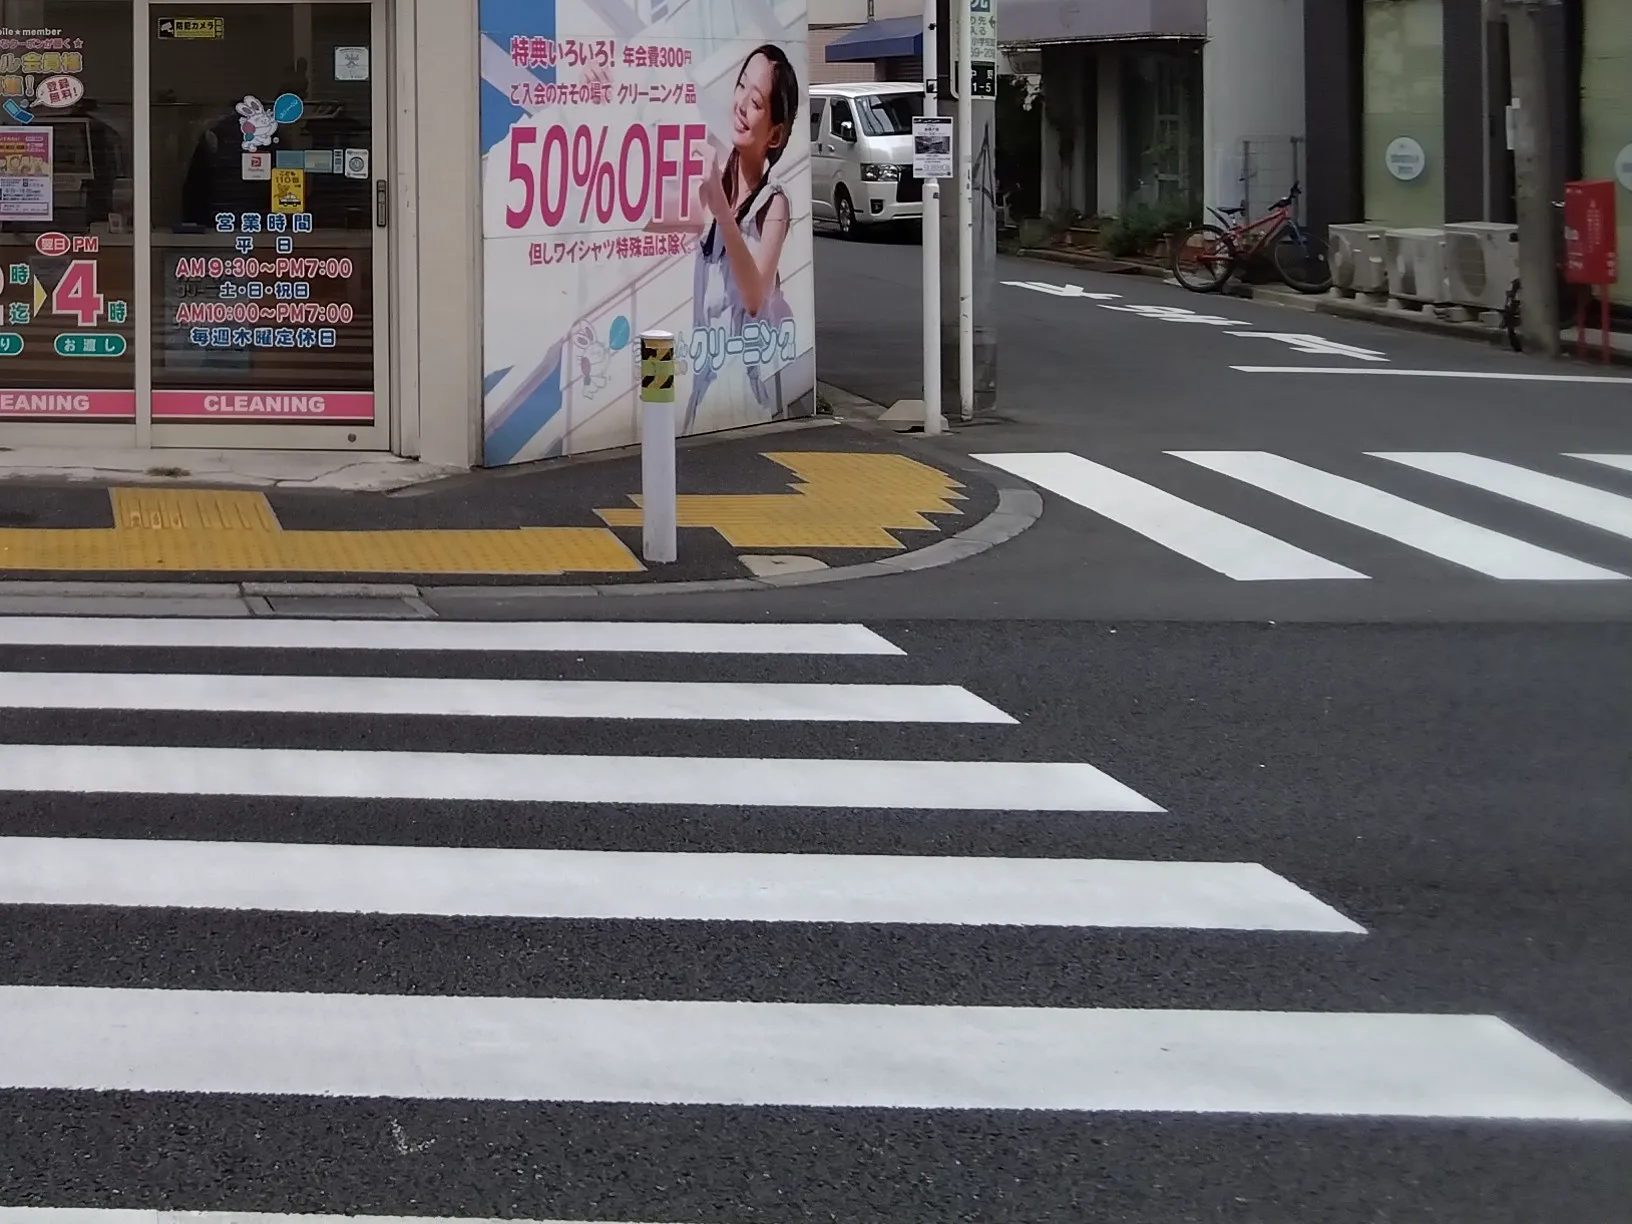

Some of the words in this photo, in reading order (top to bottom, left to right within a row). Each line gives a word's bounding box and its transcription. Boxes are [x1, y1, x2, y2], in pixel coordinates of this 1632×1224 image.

[623, 45, 693, 68] 年会費300円
[510, 82, 613, 105] ご入会の方その場で
[617, 83, 697, 105] クリーニング品
[505, 122, 706, 230] 50%OFF
[216, 213, 312, 233] 営業時間
[41, 239, 67, 251] 翌日
[72, 236, 99, 253] PM
[52, 260, 104, 326] 4
[108, 301, 127, 323] 時
[64, 338, 116, 352] お渡し
[191, 328, 336, 347] 毎週木曜定休日
[689, 318, 797, 376] クリーニング
[204, 395, 325, 412] CLEANING
